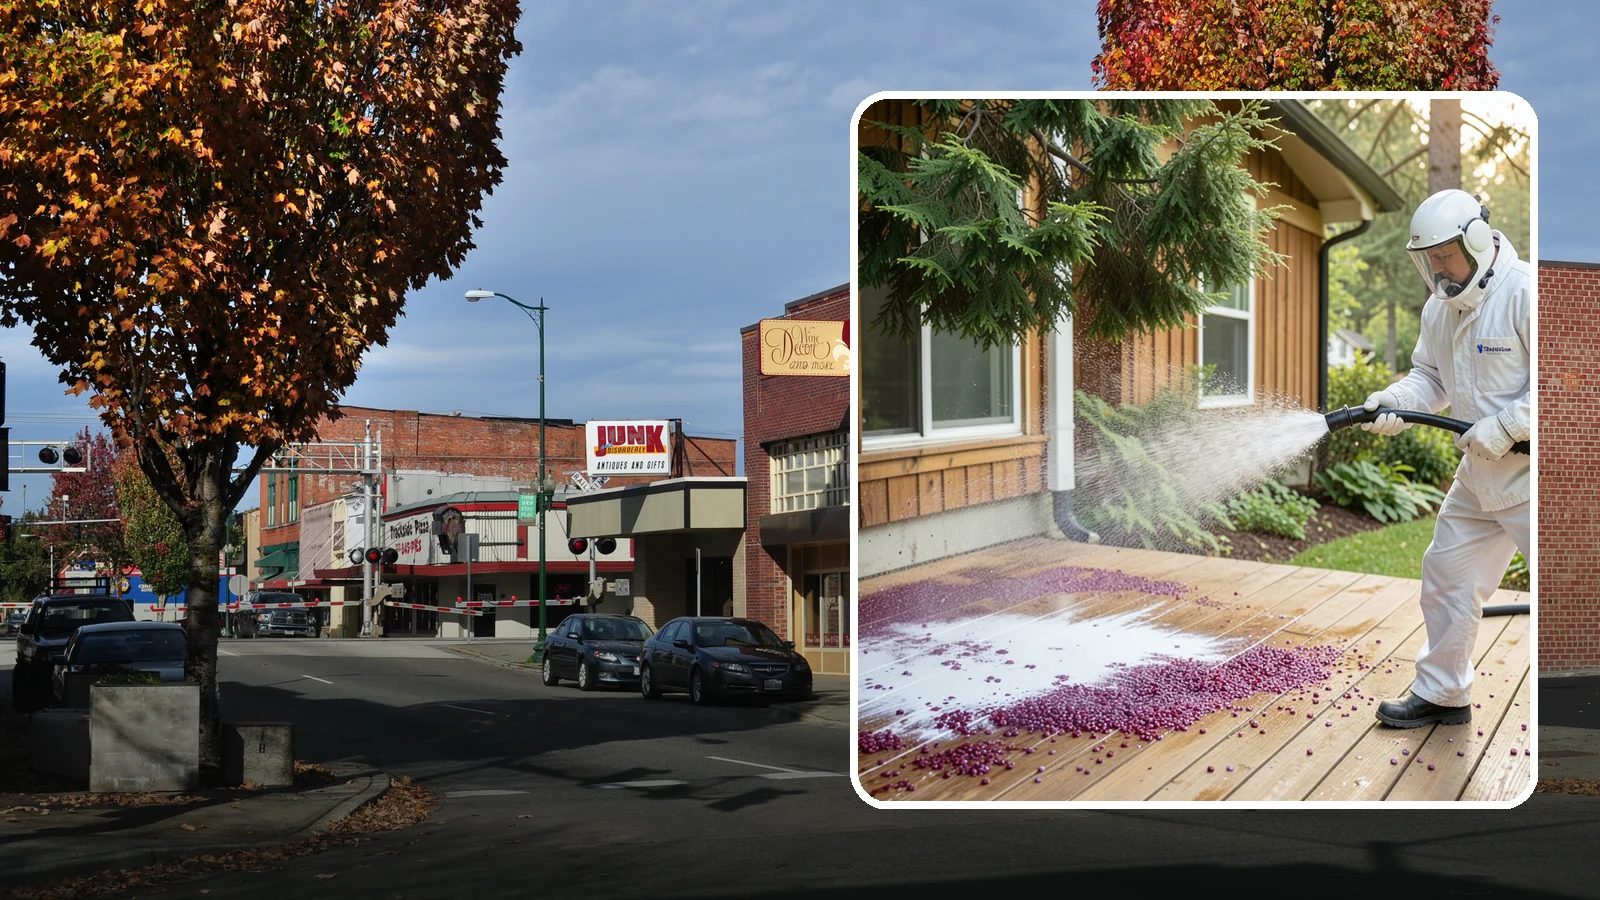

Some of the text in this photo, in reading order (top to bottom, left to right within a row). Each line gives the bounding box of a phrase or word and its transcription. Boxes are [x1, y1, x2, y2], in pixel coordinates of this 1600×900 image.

[595, 425, 665, 457] JUNK
[607, 446, 645, 454] DISORDERLY
[597, 460, 665, 470] ANTIQUES AND GIFTS
[390, 519, 429, 540] Trackside Pizza
